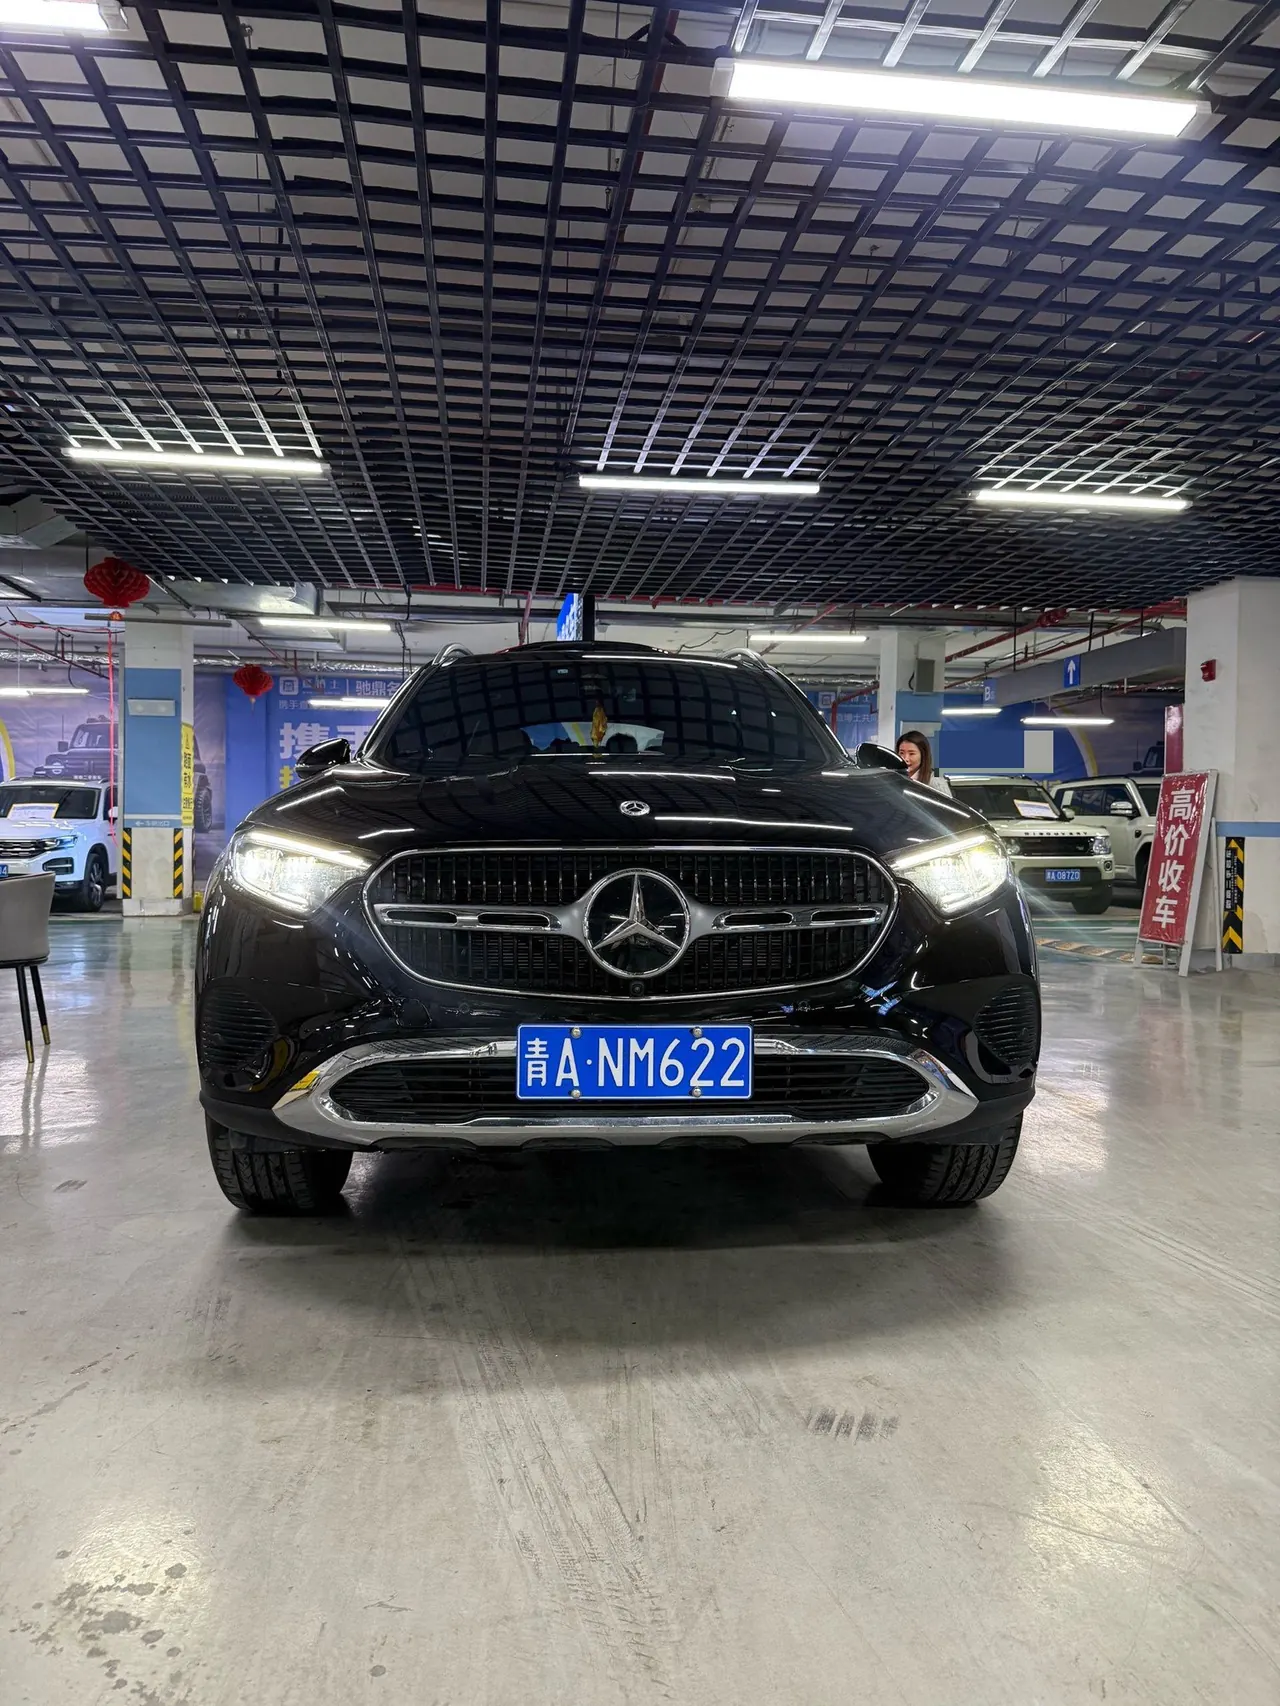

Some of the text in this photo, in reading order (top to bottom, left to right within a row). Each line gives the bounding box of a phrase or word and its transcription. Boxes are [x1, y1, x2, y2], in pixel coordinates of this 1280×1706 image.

[1152, 786, 1196, 928] 高价收车
[524, 1037, 745, 1087] 青A·NM622
